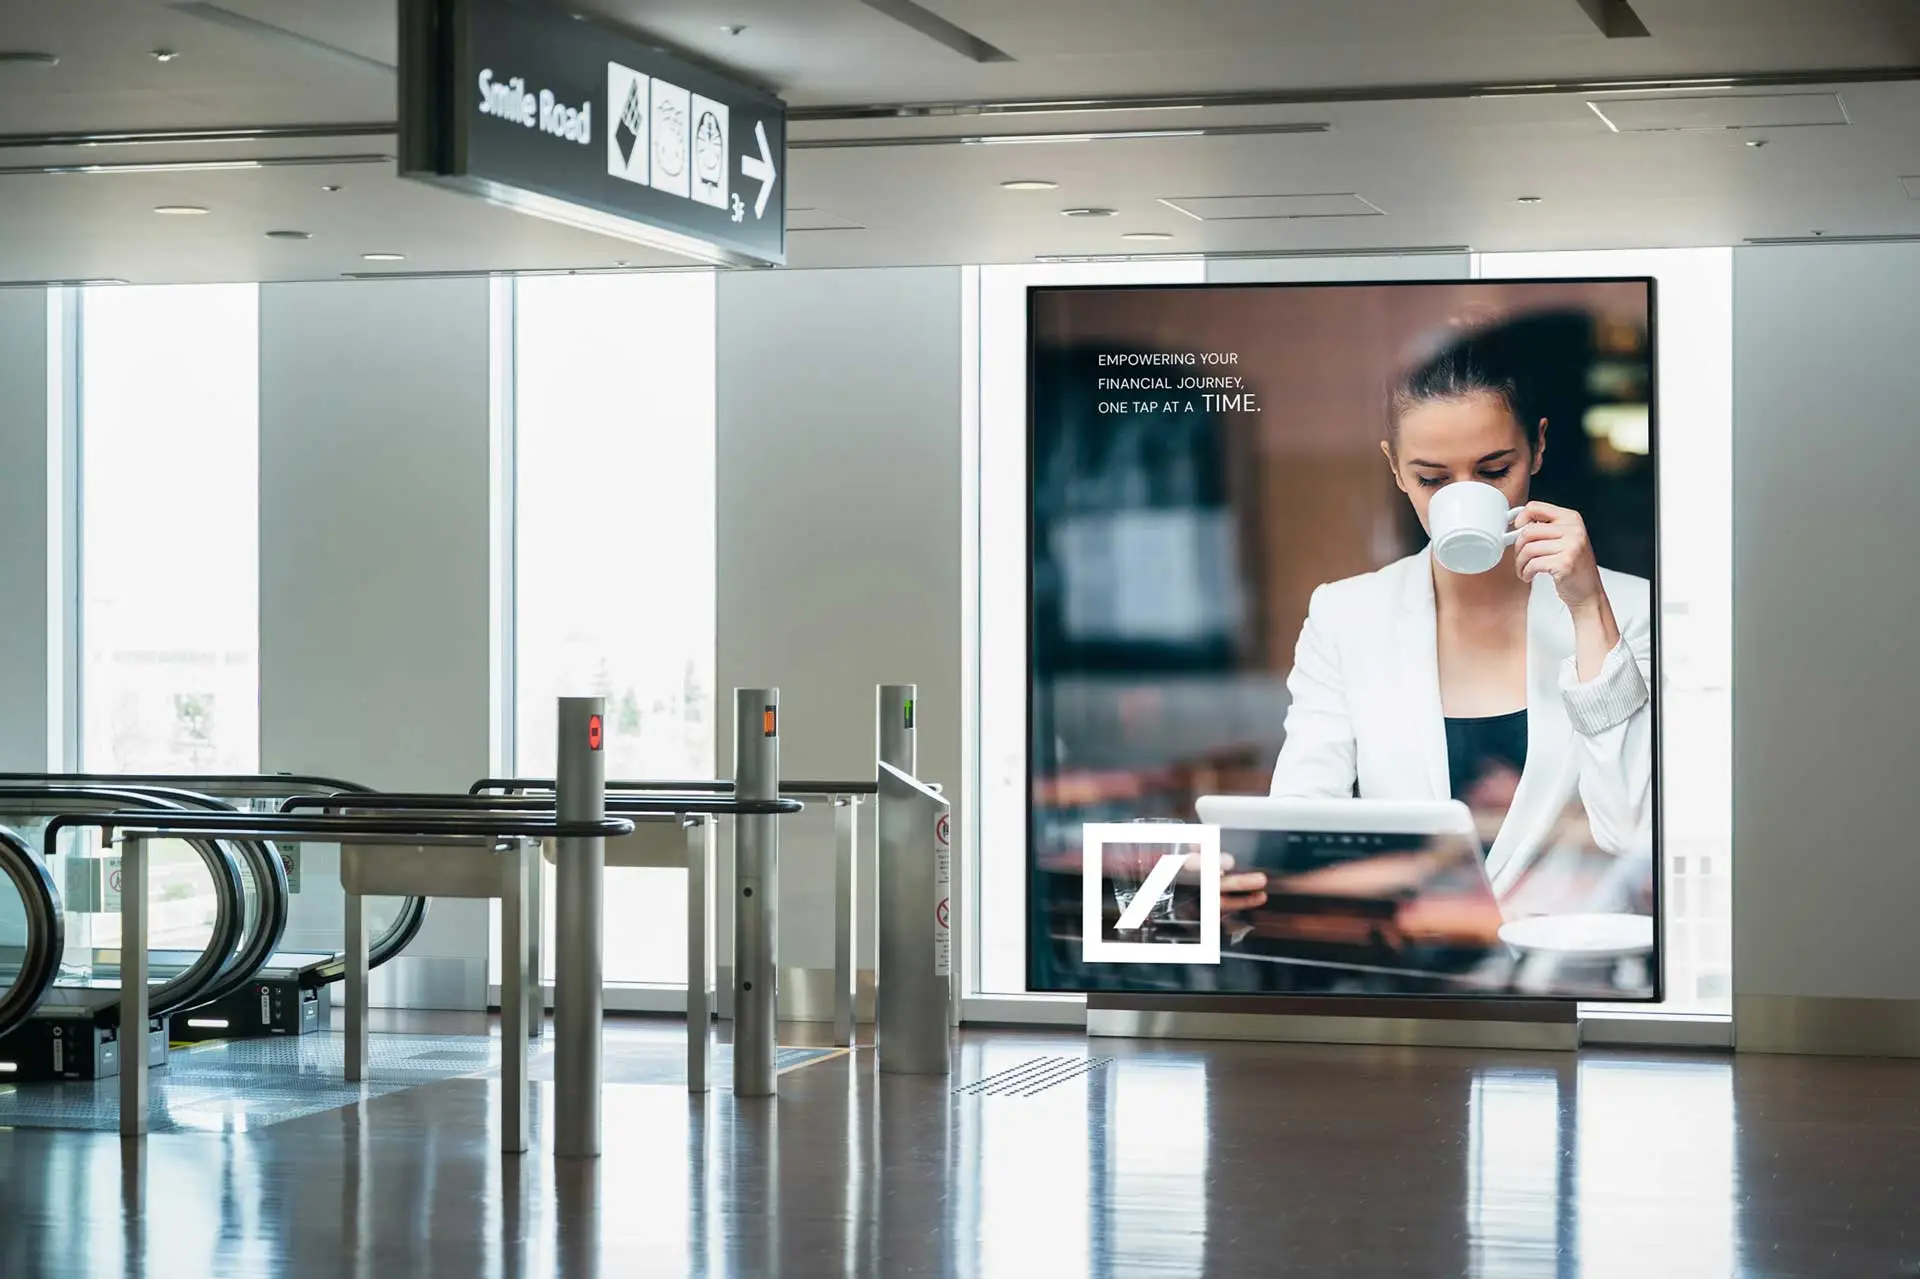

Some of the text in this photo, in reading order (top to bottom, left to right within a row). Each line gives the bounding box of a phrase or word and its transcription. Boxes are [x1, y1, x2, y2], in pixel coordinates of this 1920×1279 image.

[479, 68, 591, 144] Smile Road
[1098, 352, 1238, 366] EMPOWERING YOUR
[1098, 376, 1245, 390] FINANCIAL JOURNEY,
[1098, 393, 1262, 414] ONE TAP AT A TIME.
